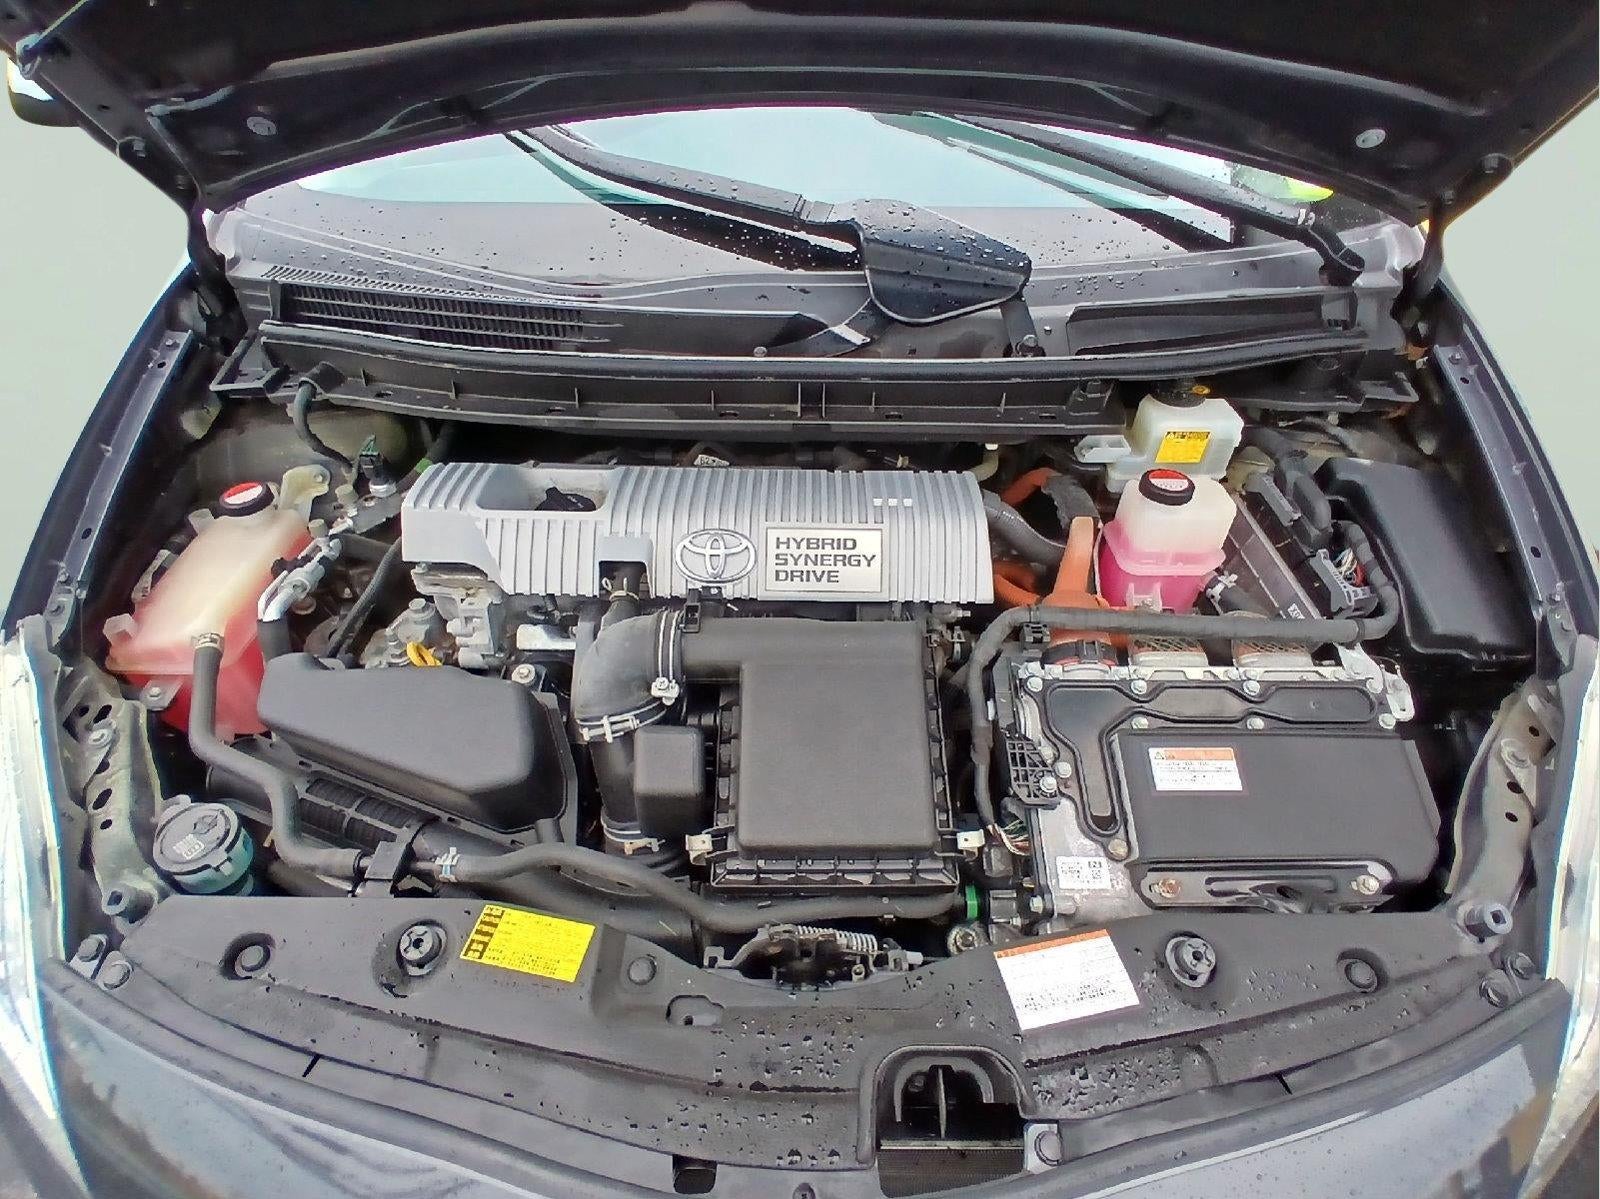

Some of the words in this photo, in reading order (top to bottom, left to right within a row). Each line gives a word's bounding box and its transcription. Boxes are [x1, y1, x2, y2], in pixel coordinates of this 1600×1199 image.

[775, 536, 857, 551] HYBRID
[774, 553, 877, 568] SYNERGY
[774, 569, 840, 584] DRIVE
